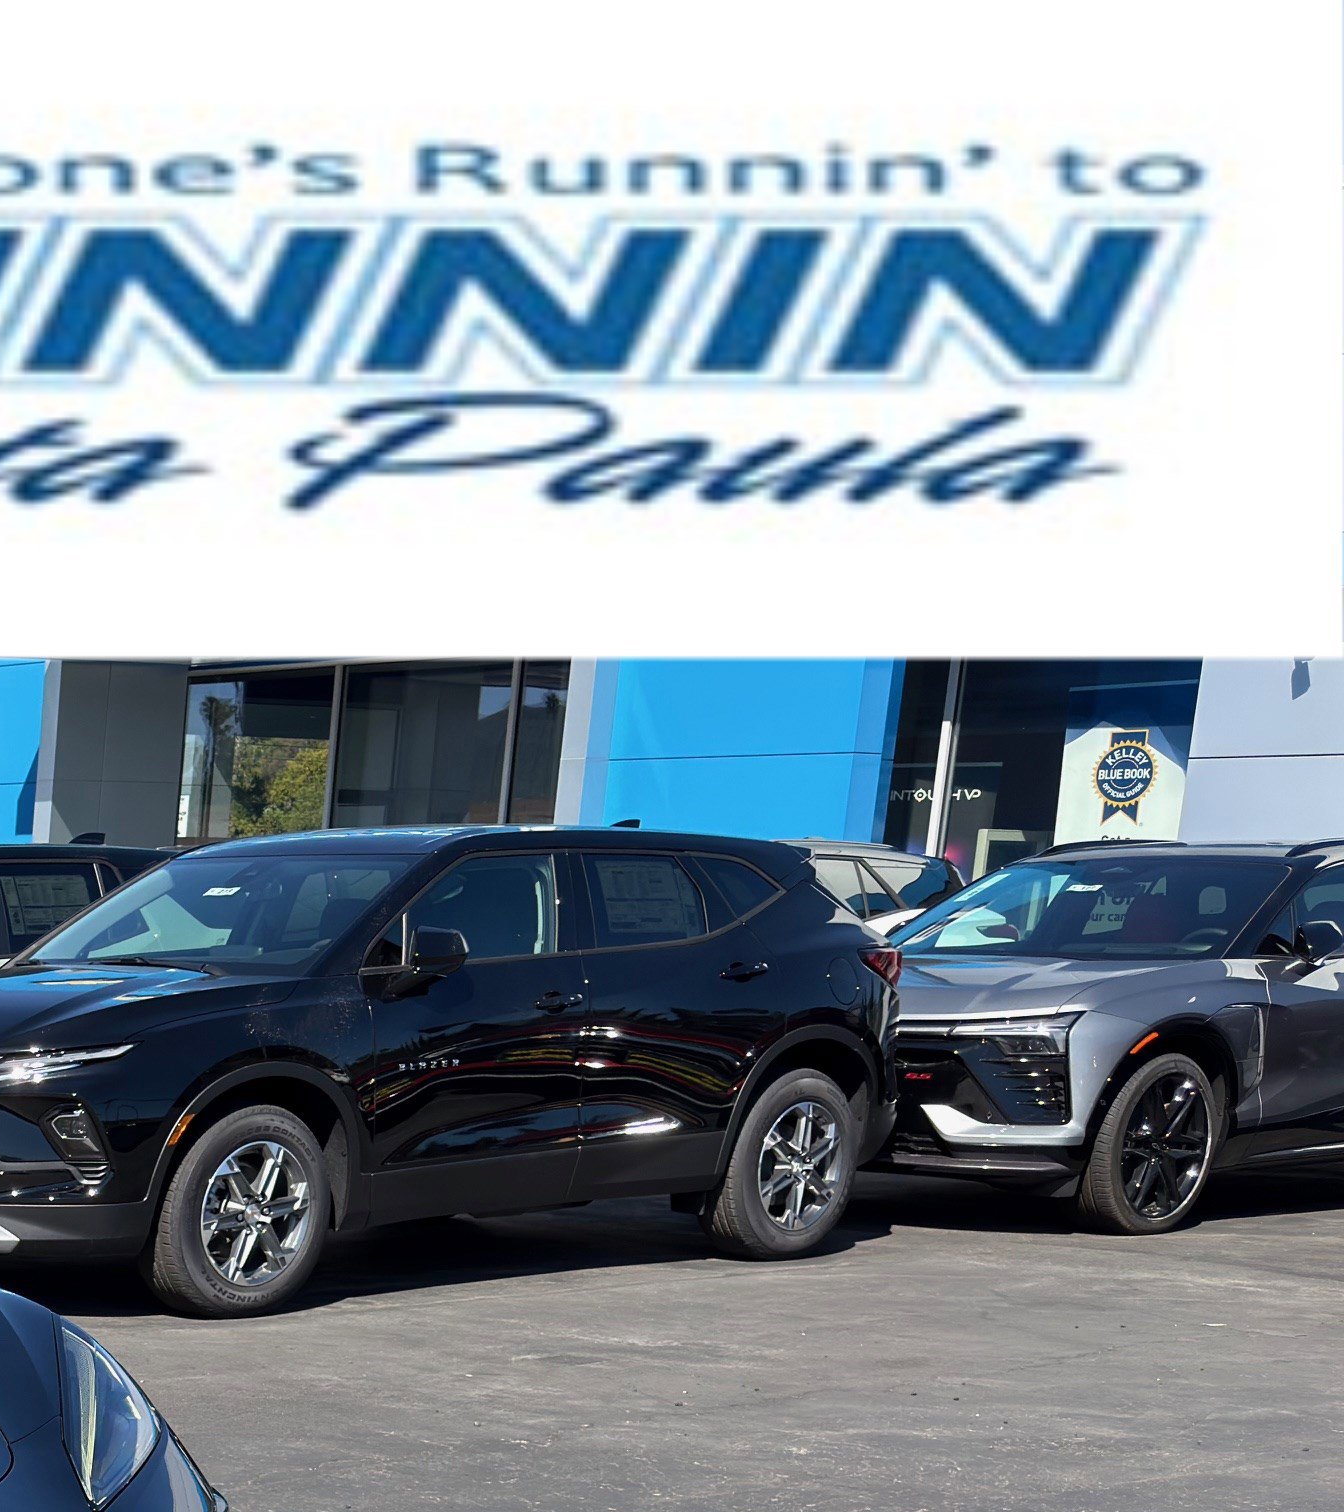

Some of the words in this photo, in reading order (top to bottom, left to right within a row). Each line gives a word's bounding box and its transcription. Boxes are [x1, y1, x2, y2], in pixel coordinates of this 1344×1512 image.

[1105, 748, 1149, 766] KELLEY
[1098, 769, 1123, 780] BLUE
[1124, 768, 1151, 779] BOOK
[1102, 782, 1126, 798] OFFICIAL
[1126, 782, 1145, 797] GUIDE
[398, 1059, 460, 1072] BLAZER
